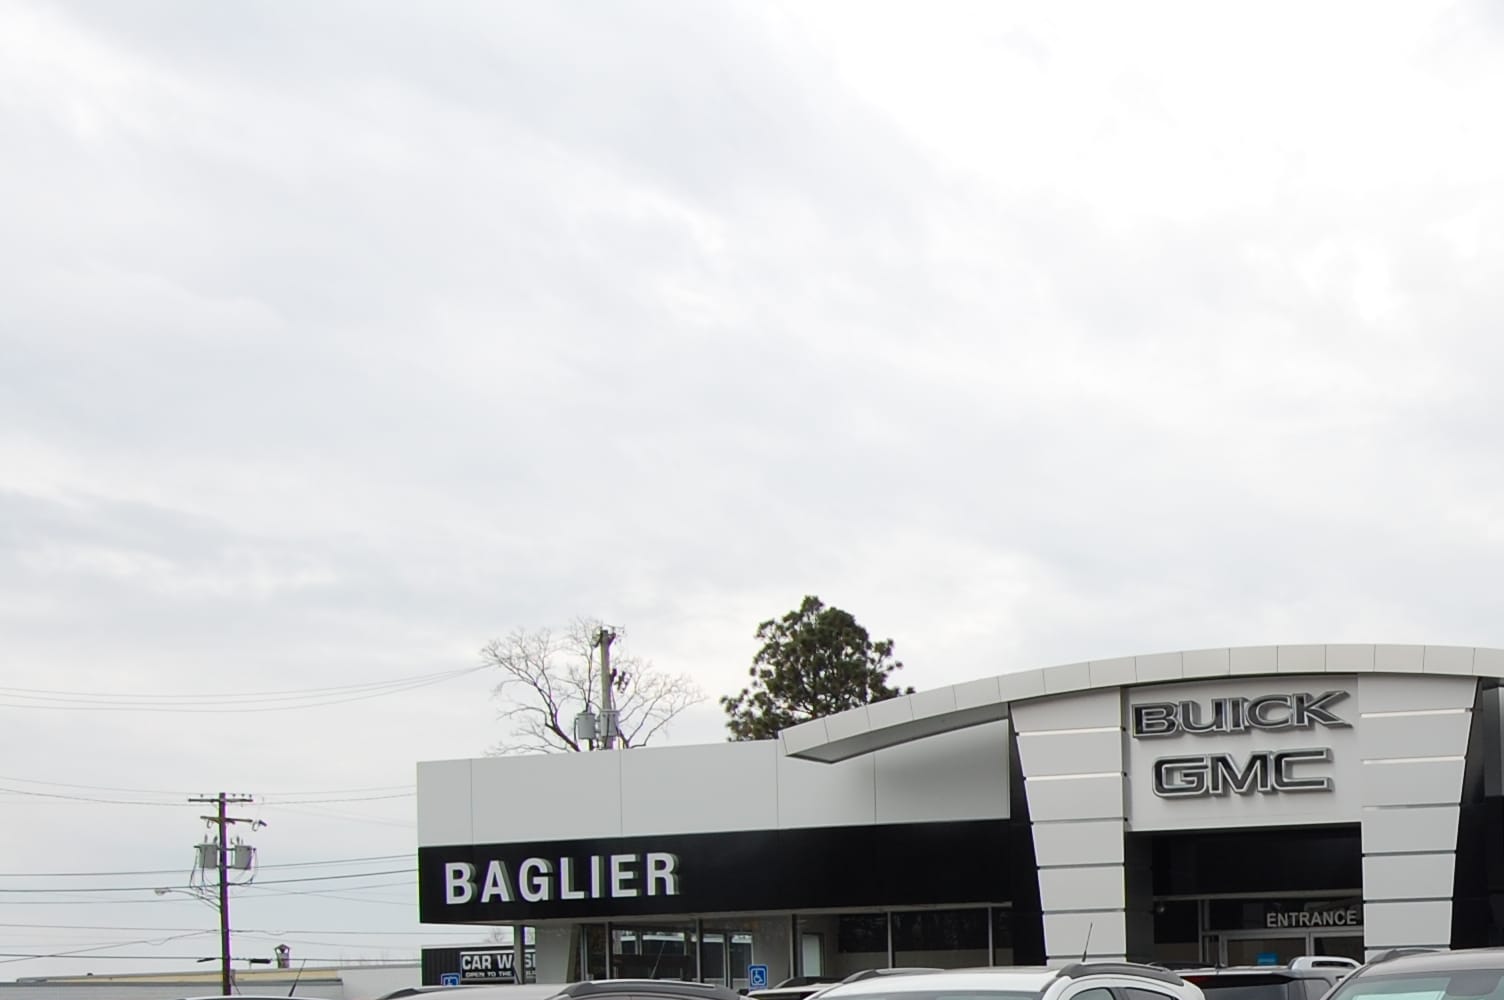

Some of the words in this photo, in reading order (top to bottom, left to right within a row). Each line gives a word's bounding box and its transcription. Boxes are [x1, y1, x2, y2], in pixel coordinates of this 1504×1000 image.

[1131, 690, 1353, 740] BUICK
[1152, 747, 1335, 798] GMC
[445, 852, 680, 905] BAGLIER
[1266, 910, 1357, 928] ENTRANCE
[462, 955, 491, 970] CAR
